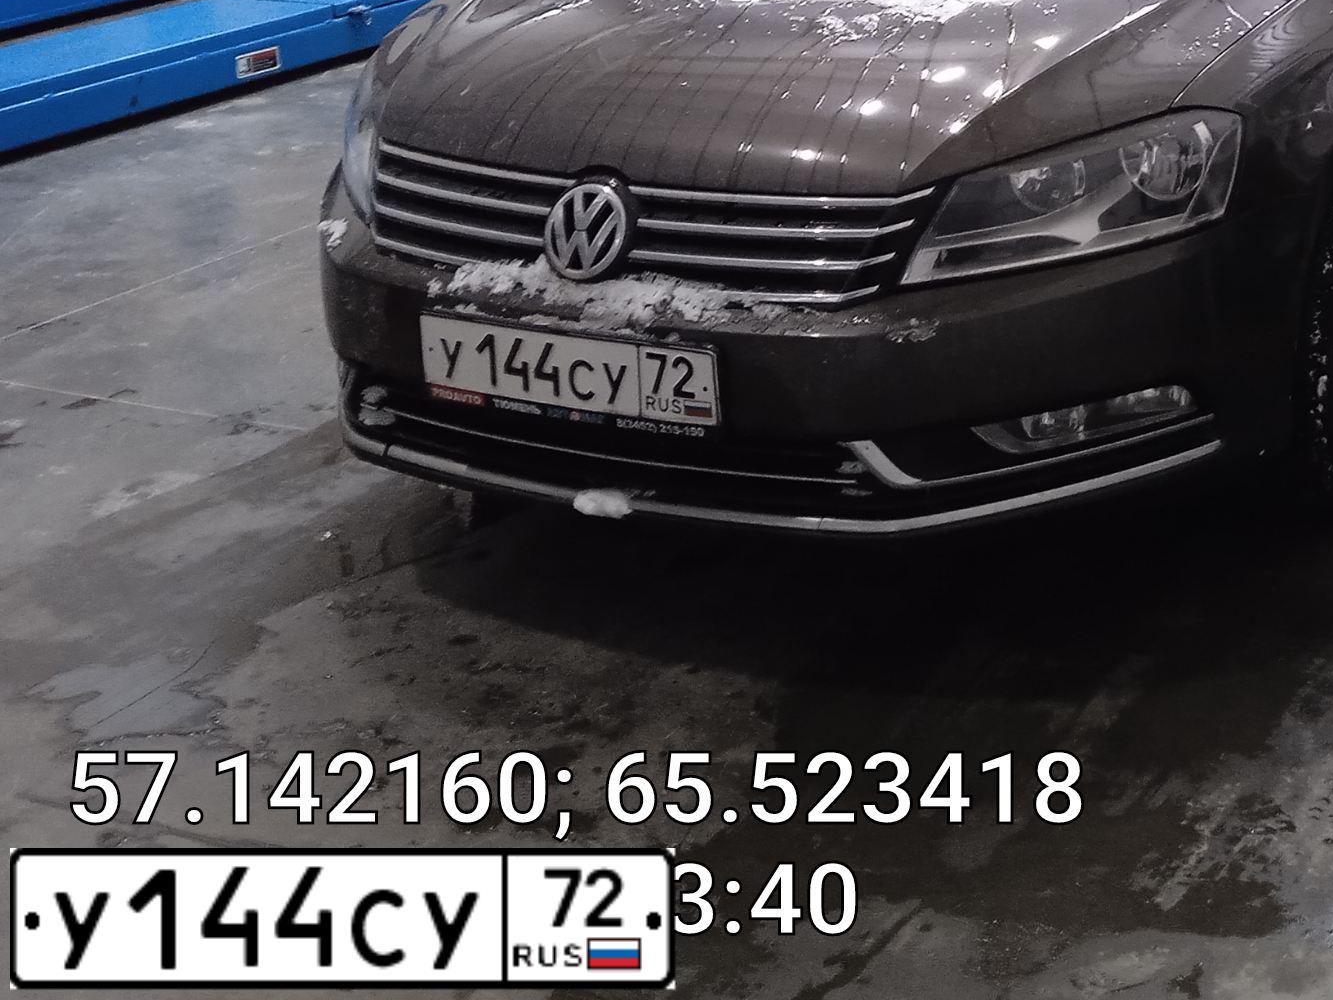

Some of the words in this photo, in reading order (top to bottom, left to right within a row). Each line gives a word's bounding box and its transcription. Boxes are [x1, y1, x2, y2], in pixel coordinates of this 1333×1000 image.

[440, 333, 628, 405] У144СУ
[645, 351, 696, 400] 72
[645, 395, 682, 414] RUS
